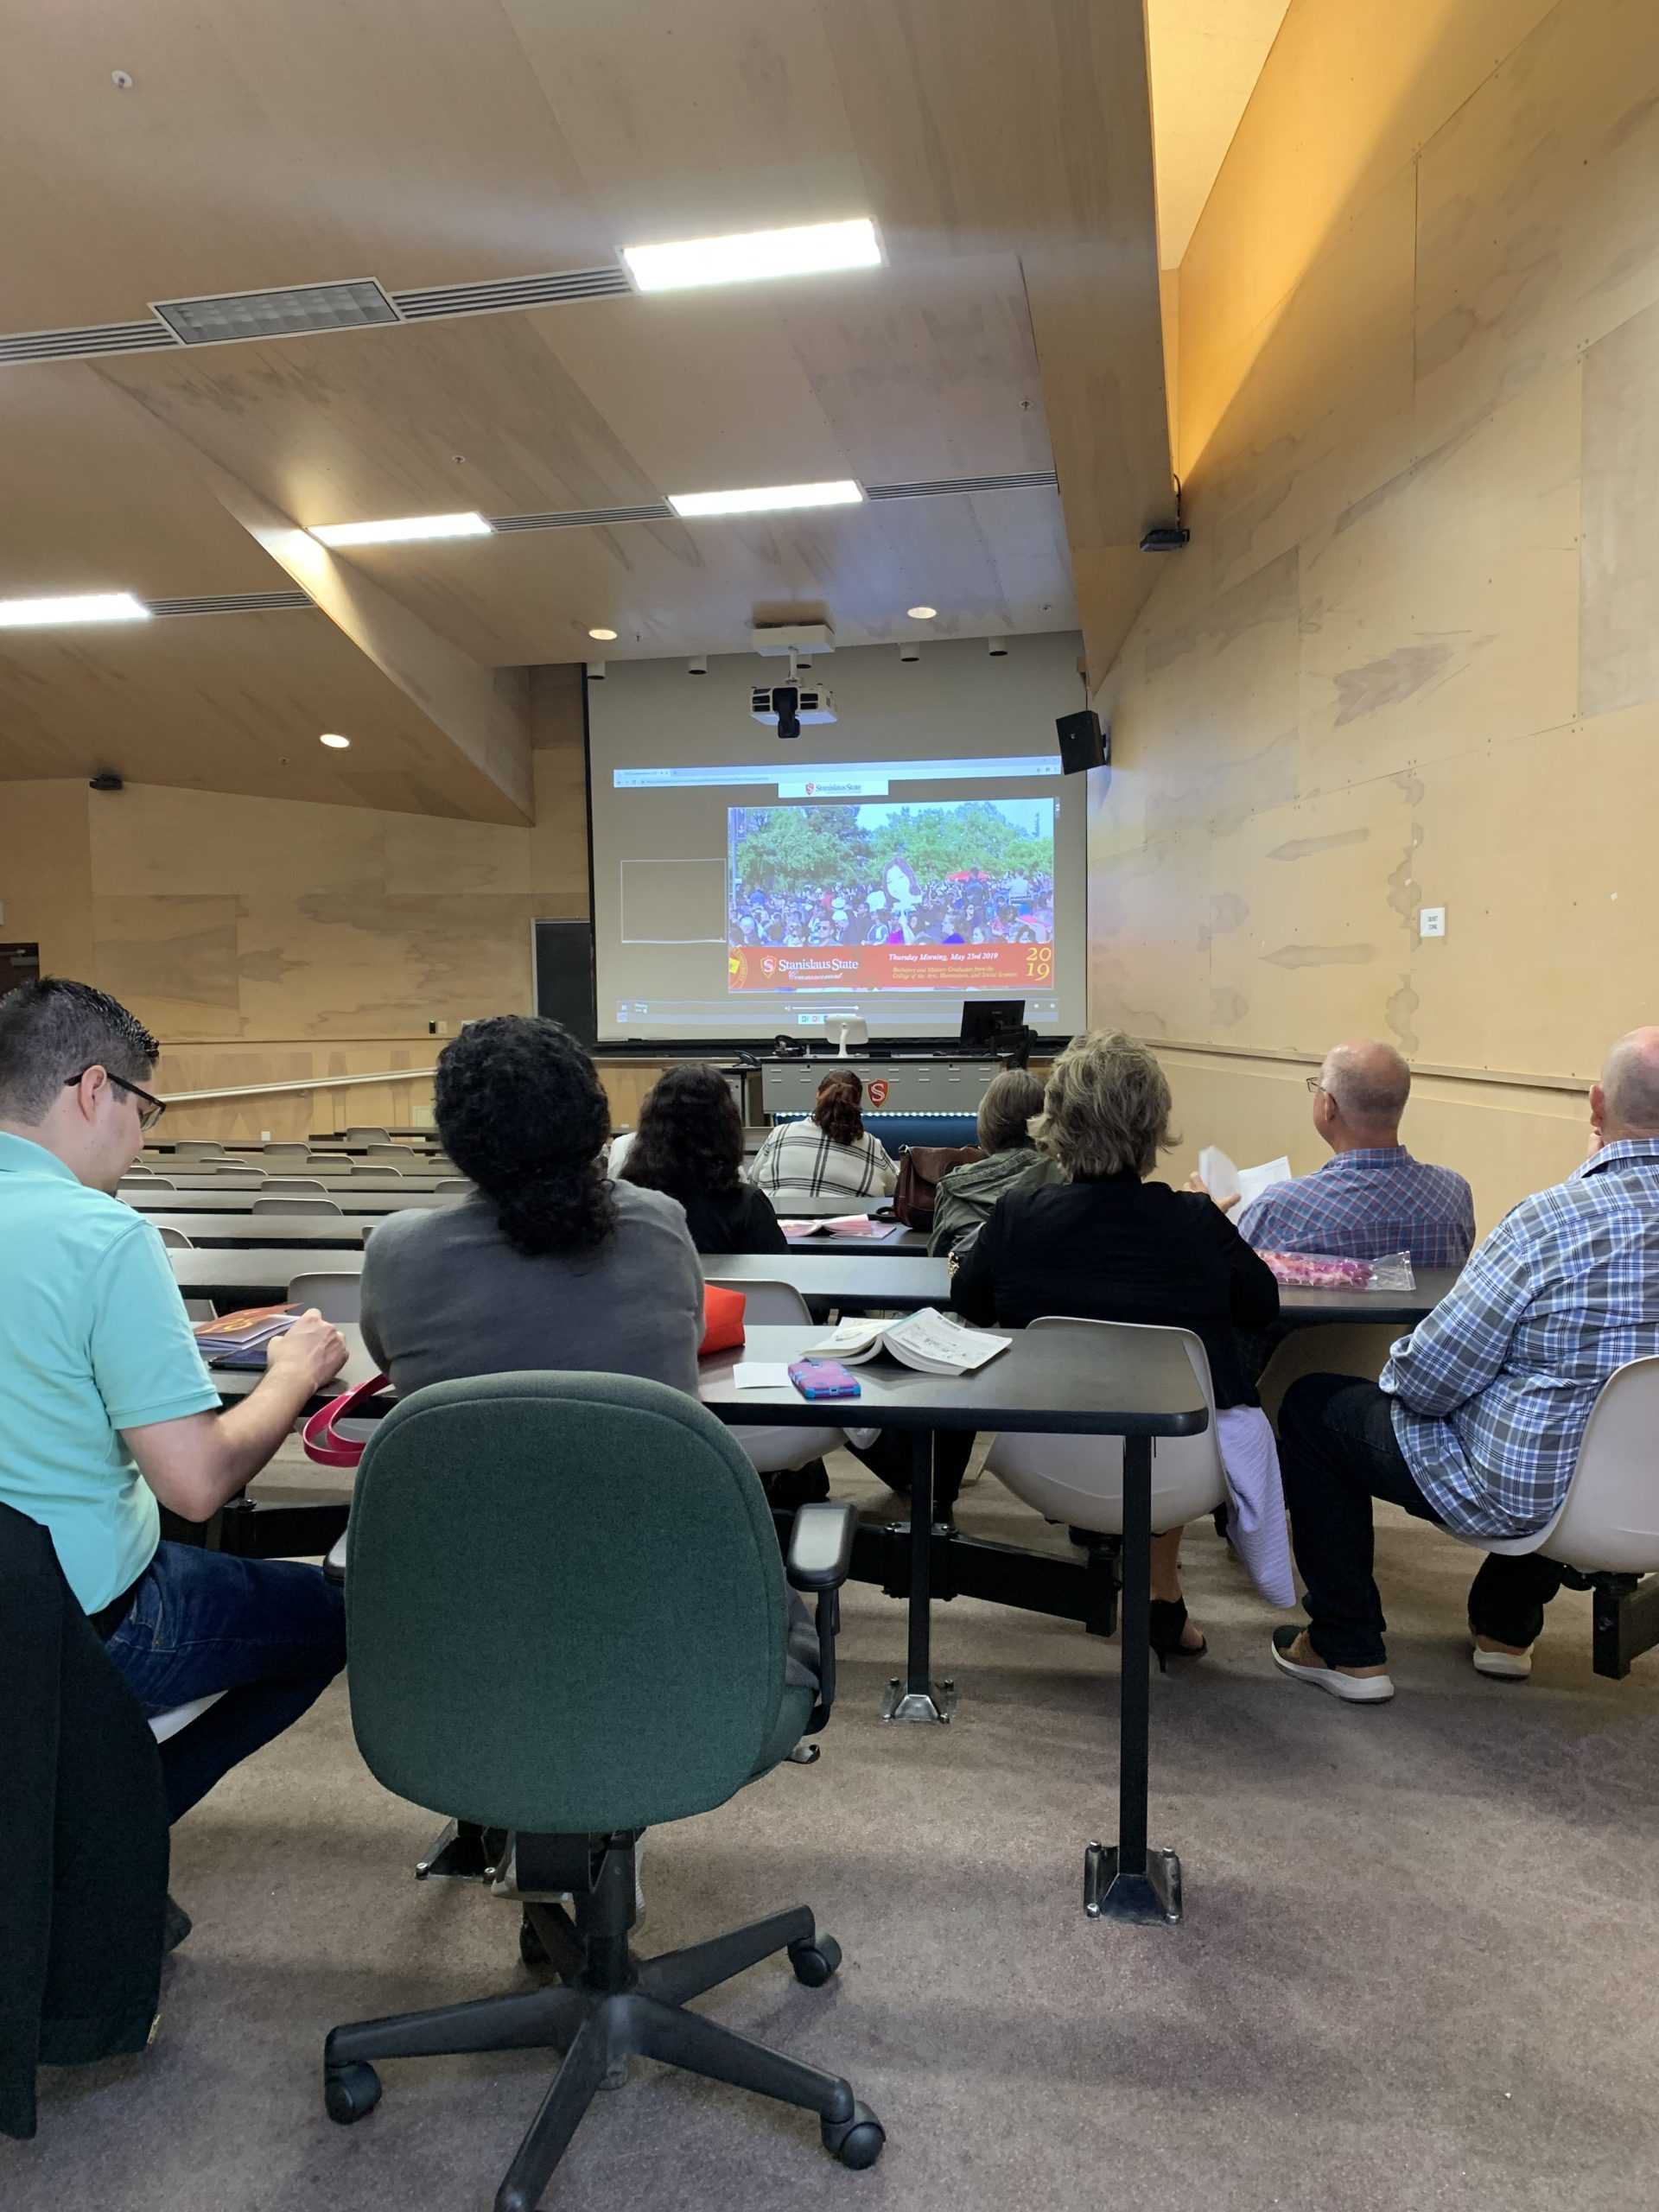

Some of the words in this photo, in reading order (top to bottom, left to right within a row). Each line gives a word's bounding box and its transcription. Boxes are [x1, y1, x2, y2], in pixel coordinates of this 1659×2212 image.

[888, 953, 918, 962] Thursday
[950, 953, 965, 962] May
[1026, 947, 1052, 961] 20
[763, 958, 774, 973] S
[779, 958, 830, 972] Stanislaus
[831, 957, 859, 971] State
[1026, 963, 1051, 982] 19
[871, 1083, 886, 1102] S
